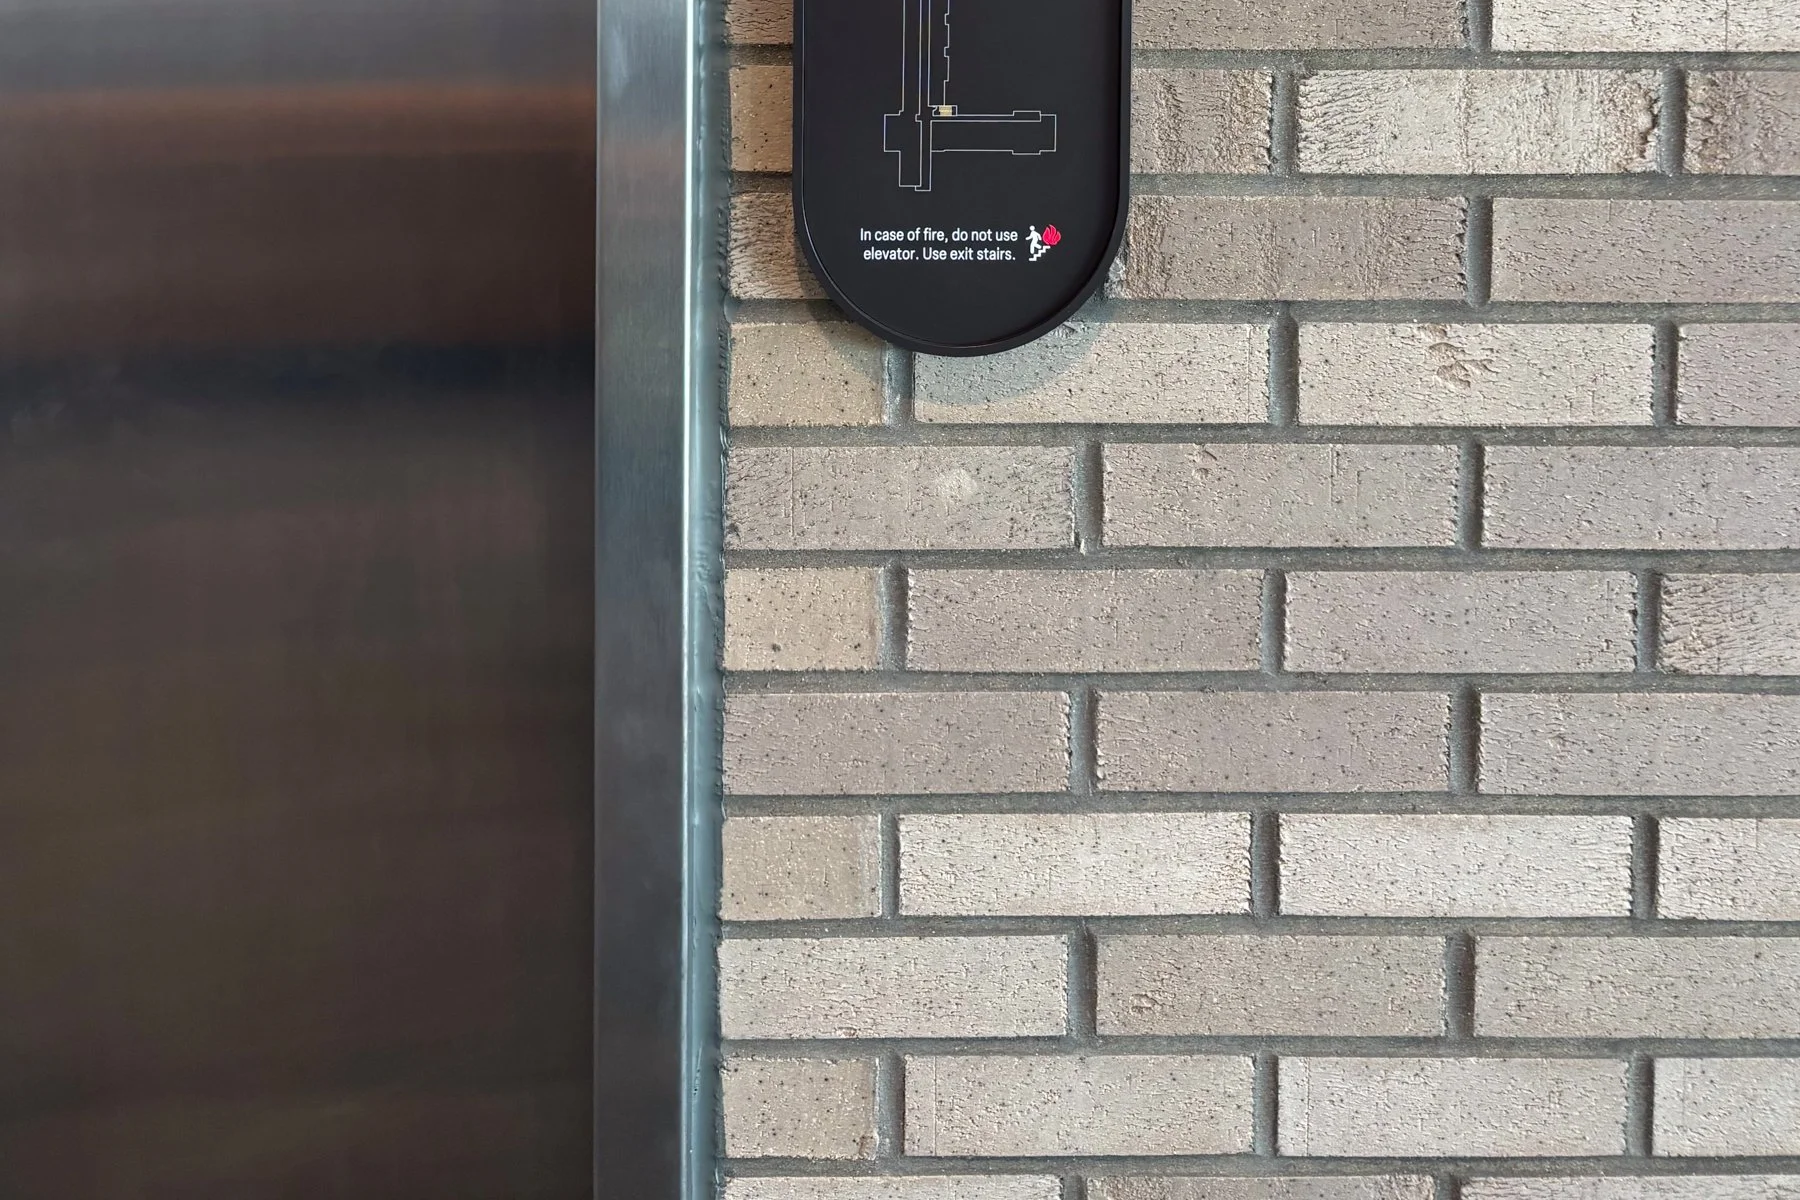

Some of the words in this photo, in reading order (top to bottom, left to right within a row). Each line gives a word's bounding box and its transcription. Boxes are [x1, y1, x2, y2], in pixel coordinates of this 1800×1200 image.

[860, 227, 872, 241] In
[874, 230, 904, 242] case
[907, 227, 921, 242] of
[923, 227, 949, 244] fire,
[951, 227, 969, 242] do
[971, 228, 992, 242] not
[995, 230, 1018, 242] use
[863, 246, 919, 261] elevator.
[922, 246, 947, 261] Use
[949, 246, 974, 261] exit
[976, 246, 1016, 261] stairs.
